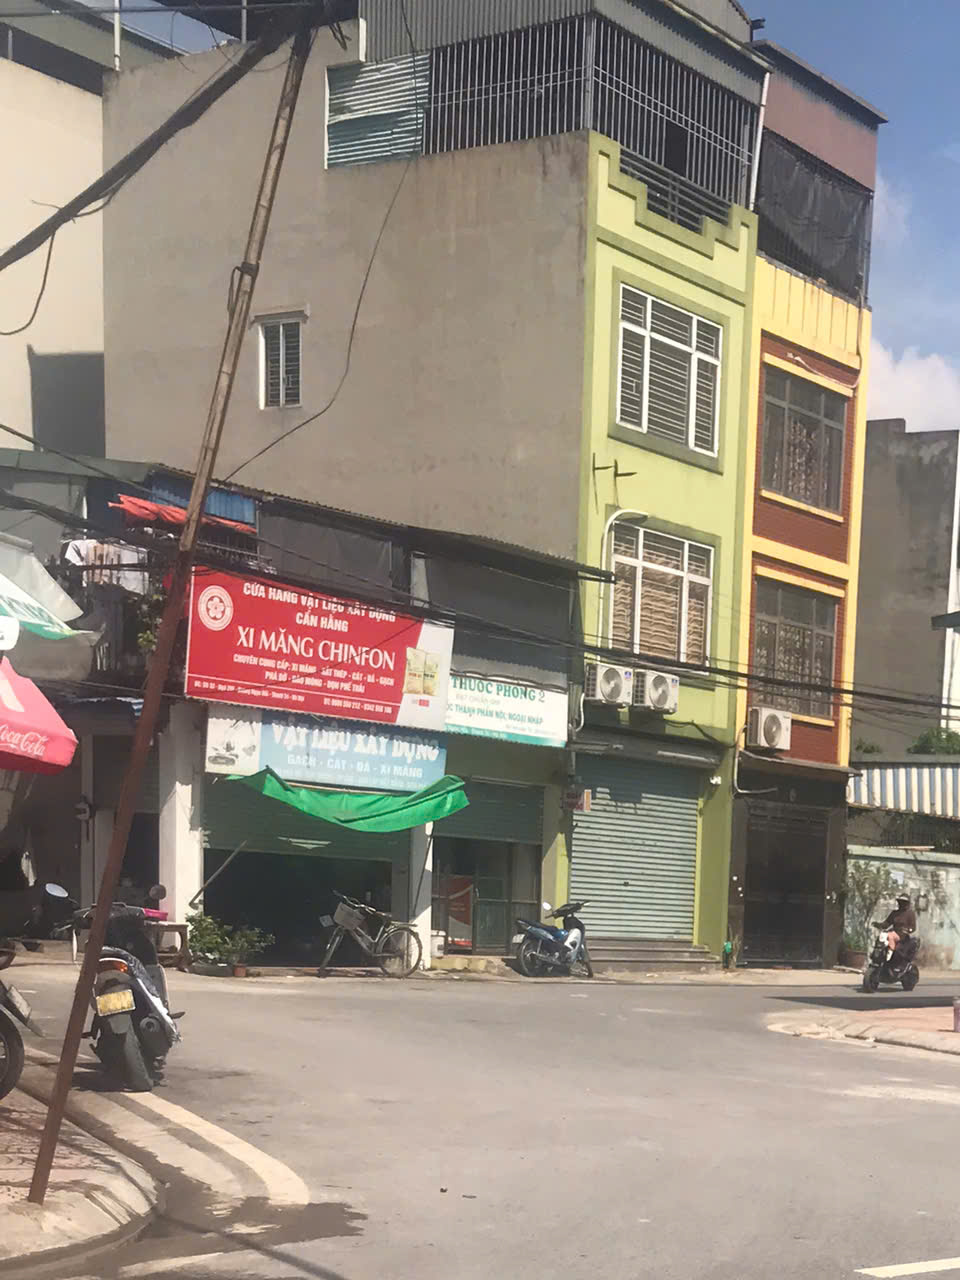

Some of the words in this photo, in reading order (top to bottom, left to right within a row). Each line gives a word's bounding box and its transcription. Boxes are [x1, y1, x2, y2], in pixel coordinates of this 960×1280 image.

[236, 625, 254, 648] XI
[258, 627, 314, 658] MĂNG
[318, 640, 396, 671] CHINFON
[538, 690, 545, 703] 2
